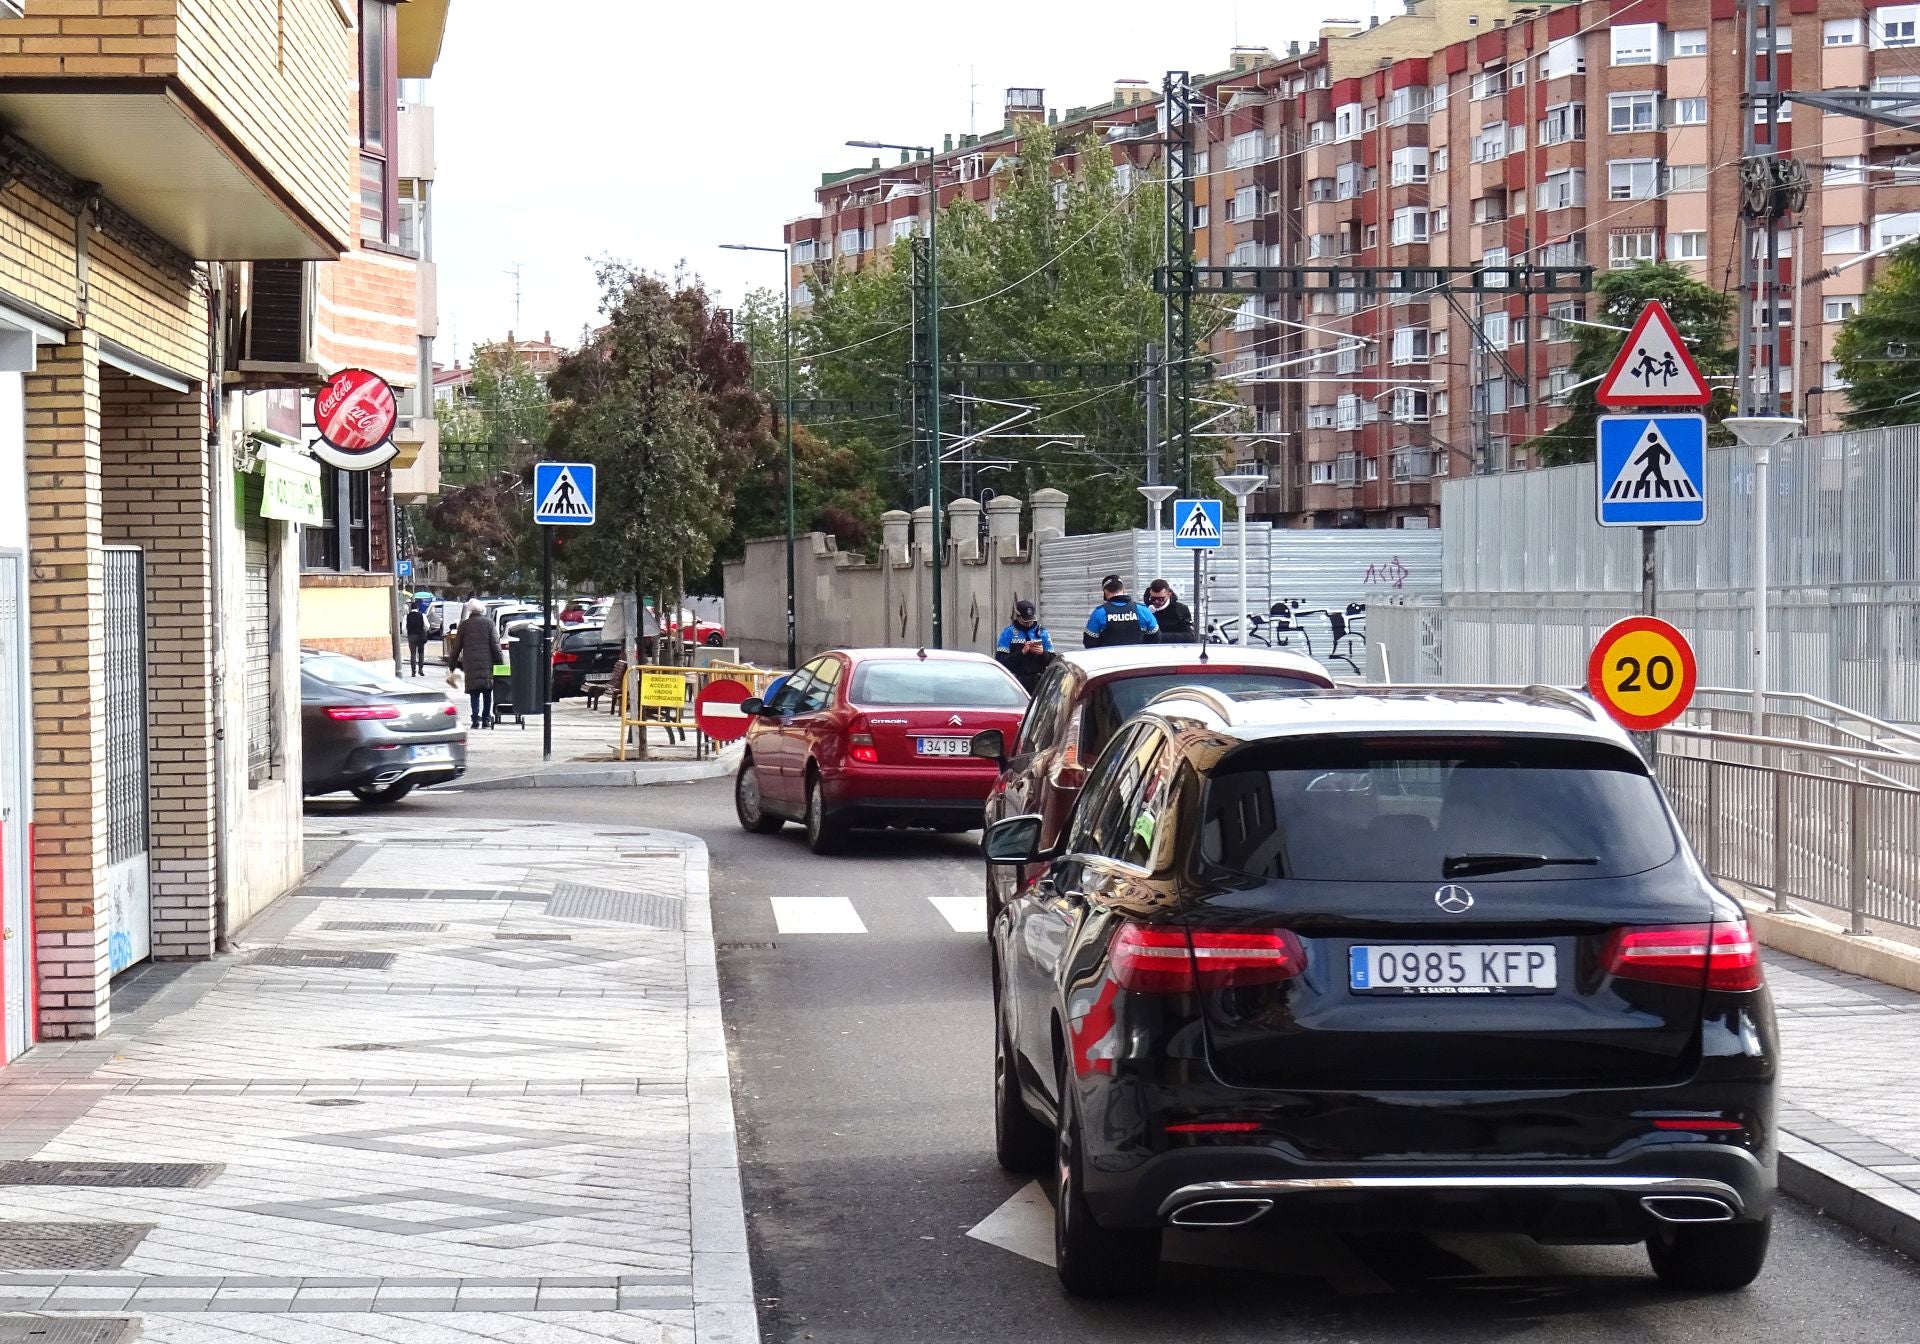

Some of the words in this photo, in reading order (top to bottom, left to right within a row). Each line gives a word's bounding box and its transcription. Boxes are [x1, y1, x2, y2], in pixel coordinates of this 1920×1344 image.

[400, 564, 408, 575] P
[1107, 611, 1138, 622] POLICÍA
[1616, 655, 1674, 692] 20
[926, 740, 956, 752] 3419
[961, 740, 972, 753] B
[1378, 952, 1466, 984] 0985
[1481, 952, 1545, 984] KFP
[1356, 972, 1364, 981] E
